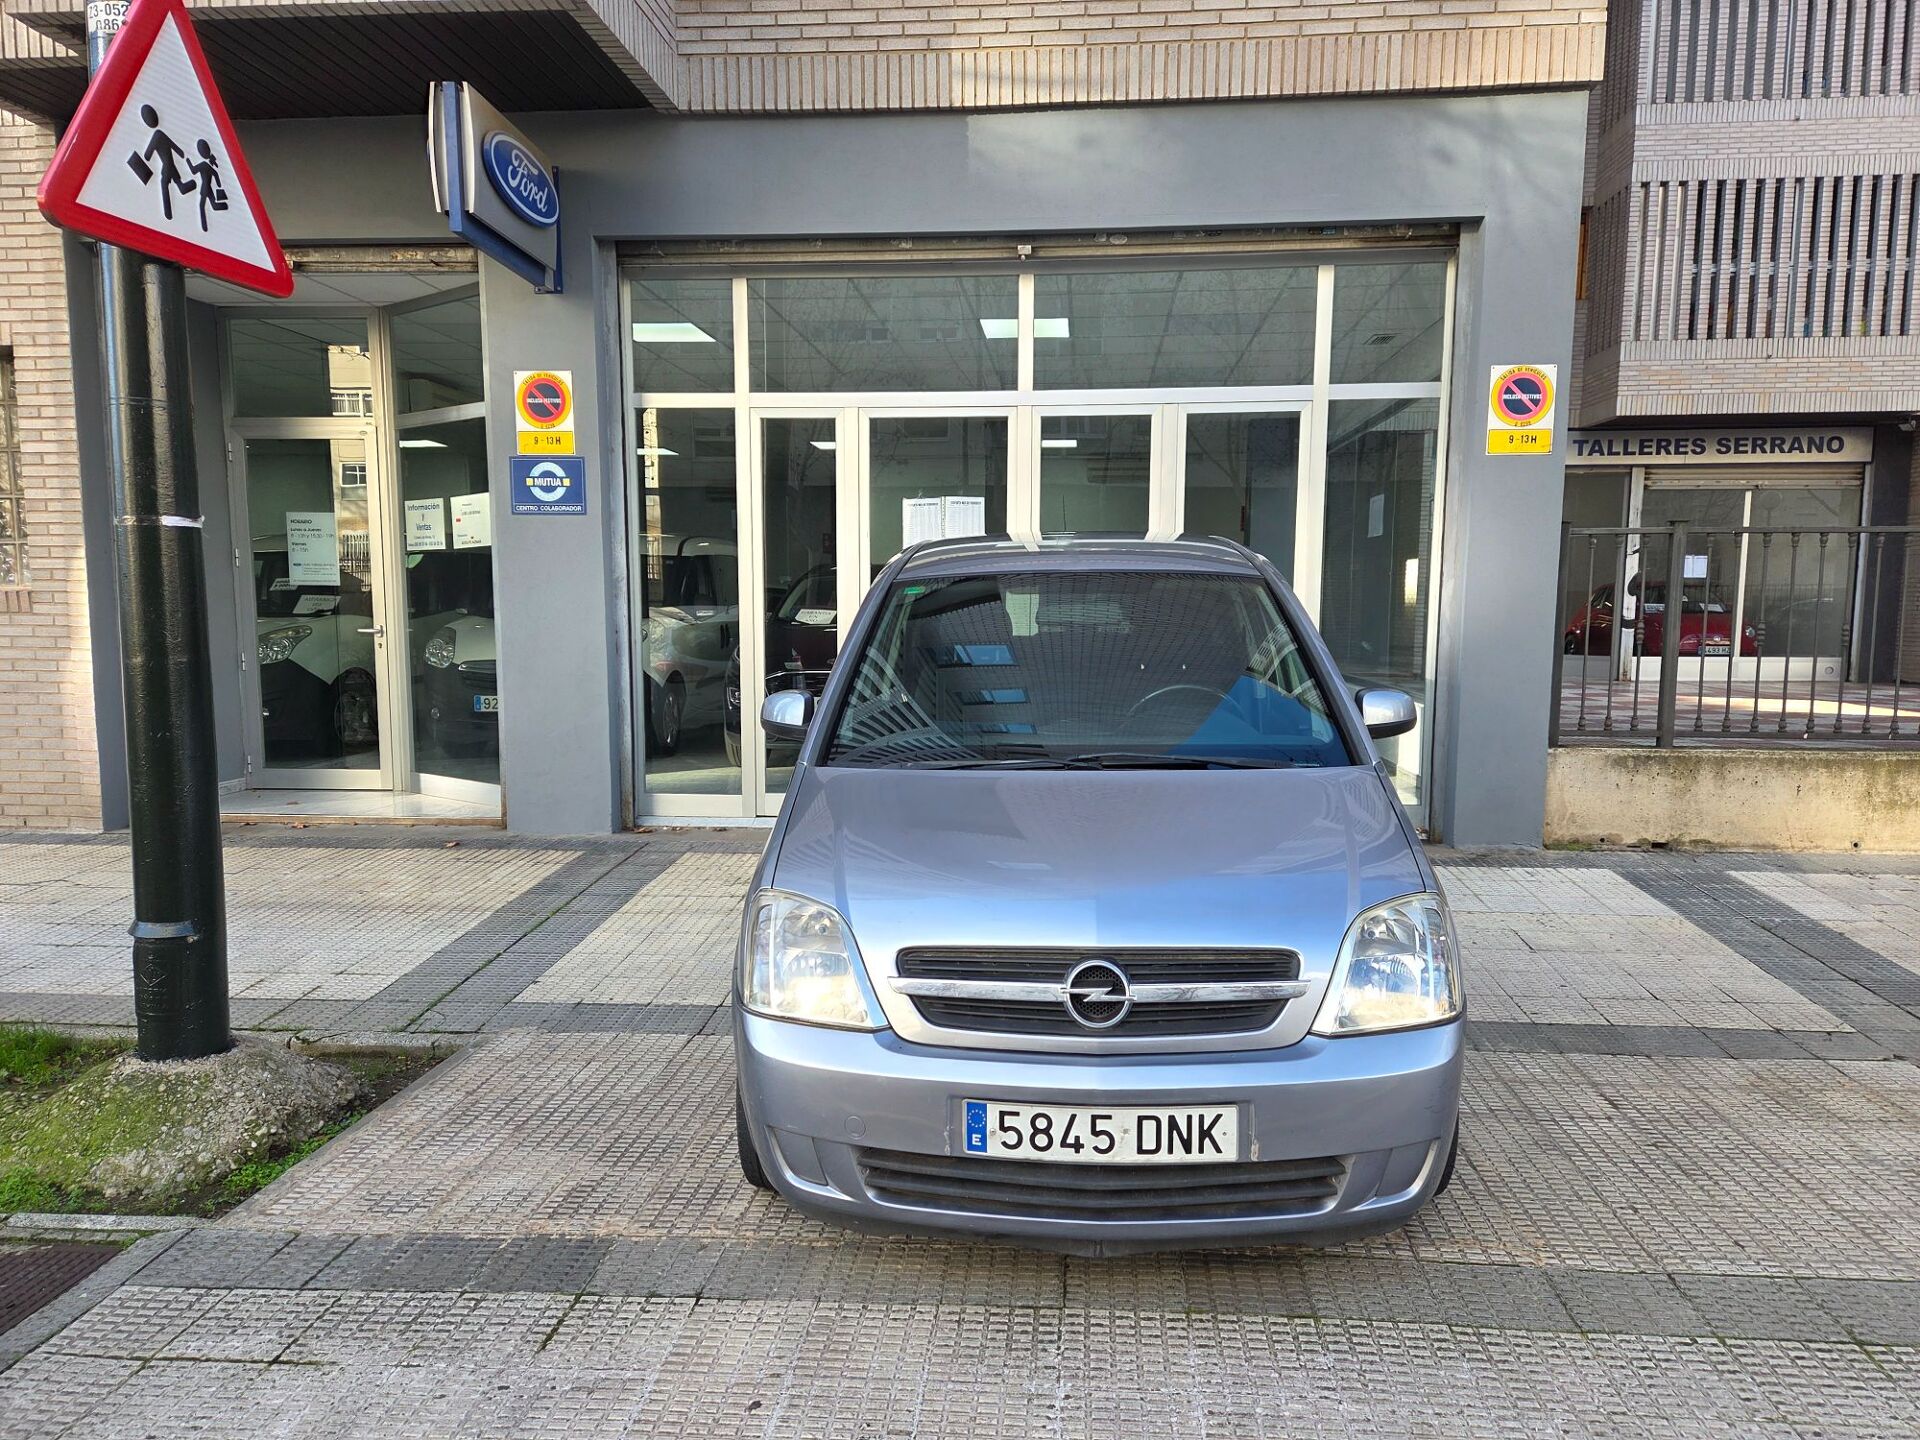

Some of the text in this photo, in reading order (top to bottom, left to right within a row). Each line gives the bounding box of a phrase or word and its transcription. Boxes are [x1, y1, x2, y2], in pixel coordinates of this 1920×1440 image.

[508, 149, 548, 212] Ford
[534, 436, 538, 445] 9
[1509, 435, 1514, 444] 9
[1572, 435, 1846, 457] TALLERES SERRANO
[534, 478, 561, 486] MUTUA
[407, 503, 440, 512] Información
[998, 1110, 1224, 1155] 5845 DNK
[972, 1134, 982, 1146] E
